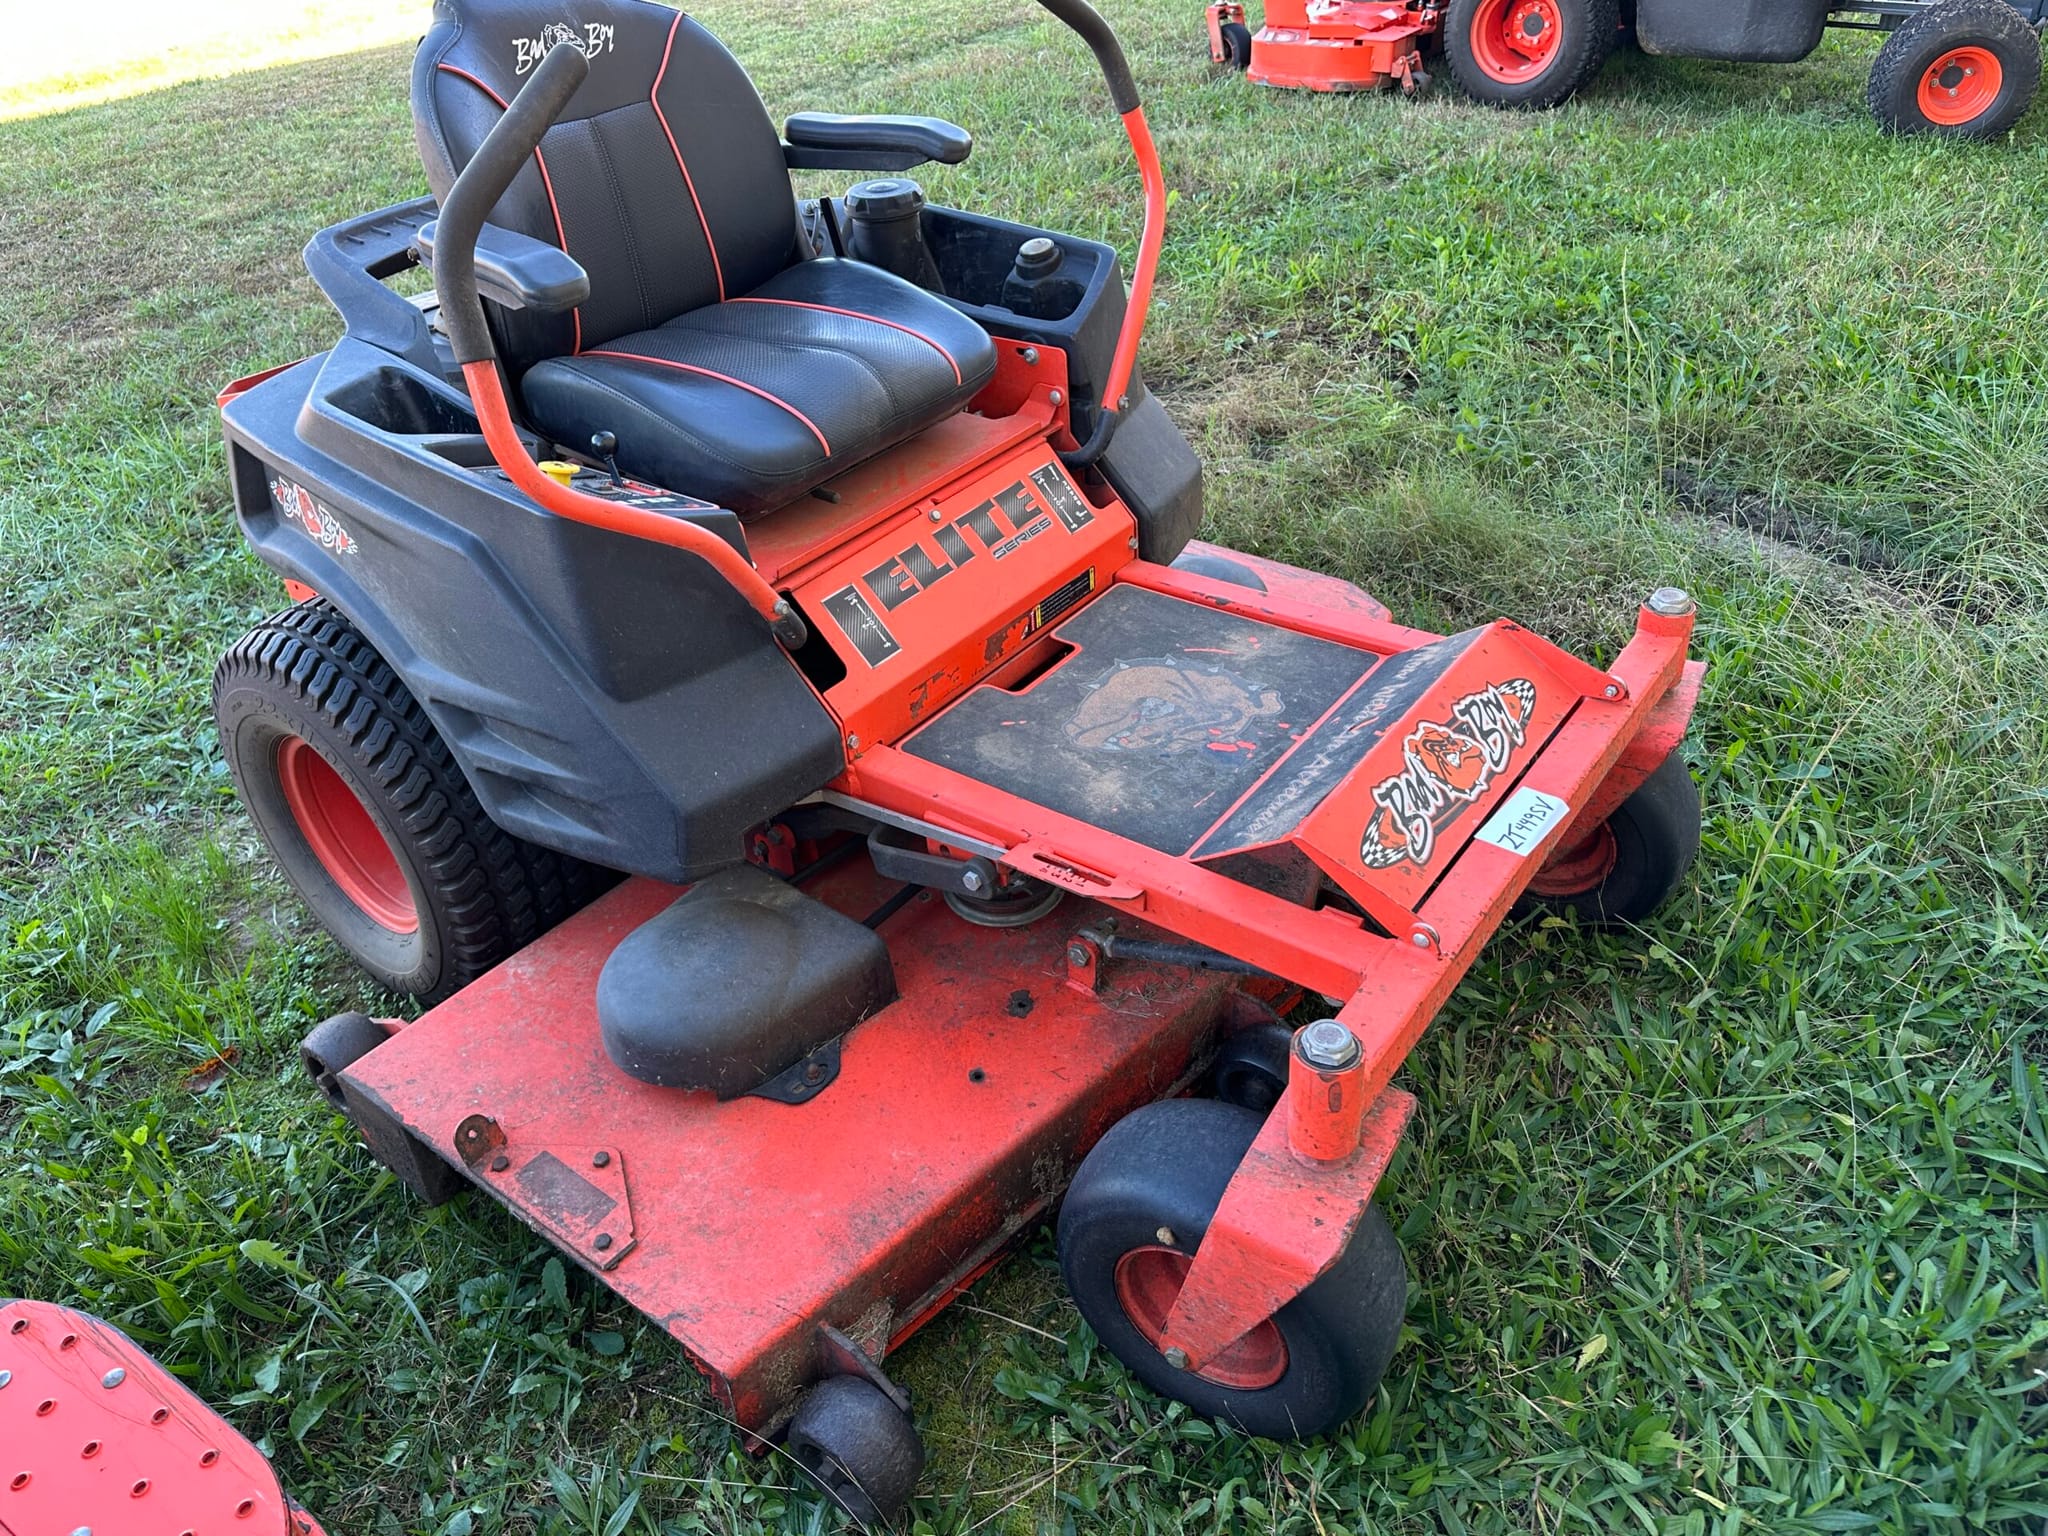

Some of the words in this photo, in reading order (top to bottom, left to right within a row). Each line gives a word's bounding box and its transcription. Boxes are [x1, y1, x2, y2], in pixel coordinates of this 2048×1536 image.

[512, 31, 547, 75] Bad
[584, 23, 615, 59] Boy
[861, 479, 1044, 613] ELITE
[993, 517, 1052, 559] SERIES
[1372, 752, 1444, 862] Bad
[1453, 683, 1525, 771] Boy
